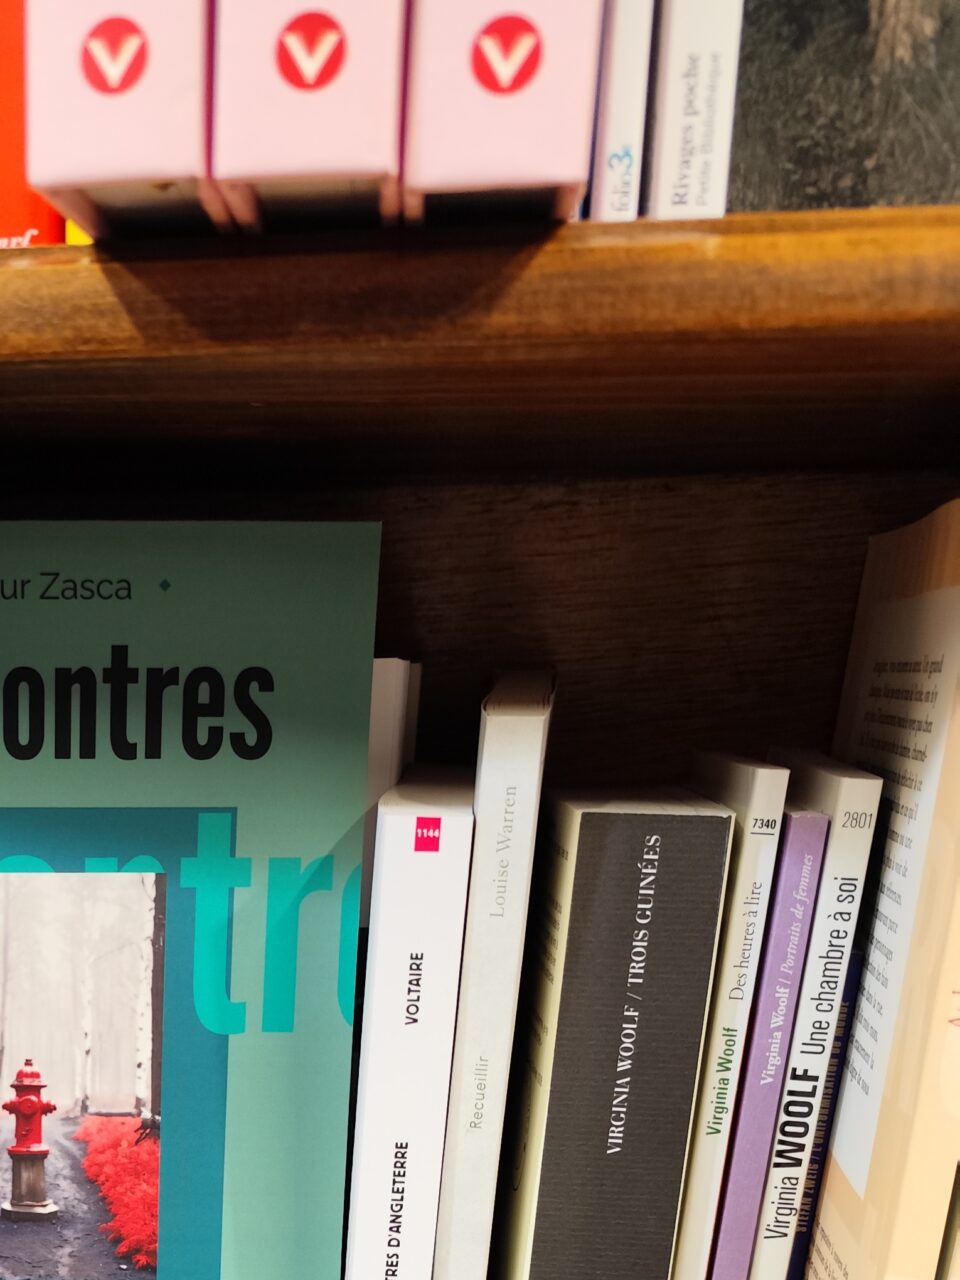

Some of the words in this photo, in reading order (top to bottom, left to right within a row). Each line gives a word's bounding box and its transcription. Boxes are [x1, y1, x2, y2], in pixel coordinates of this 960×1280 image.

[39, 572, 133, 600] Zasca
[416, 828, 440, 839] 1144
[496, 785, 517, 853] Warren
[752, 818, 777, 831] 7340
[842, 812, 873, 829] 2801
[489, 858, 510, 919] Louise
[637, 834, 662, 924] GUINÉES
[749, 882, 763, 900] lire
[795, 854, 814, 902] femmes
[837, 876, 860, 904] soi
[751, 905, 759, 918] à
[790, 901, 805, 919] de
[831, 912, 851, 922] à
[627, 931, 649, 989] TROIS
[736, 922, 755, 971] heures
[780, 918, 802, 975] Portraits
[814, 927, 849, 1014] chambre
[405, 952, 424, 1026] VOLTAIRE
[729, 976, 745, 1001] Des
[770, 985, 790, 1028] Woolf
[617, 1005, 640, 1068] WOOLF
[716, 1027, 738, 1068] Woolf
[760, 1031, 782, 1085] Virginia
[801, 1019, 830, 1055] Une
[469, 1055, 489, 1130] Recueillir
[607, 1073, 631, 1155] VIRGINIA
[706, 1071, 731, 1136] Virginia
[773, 1067, 820, 1168] WOOLF
[388, 1141, 409, 1247] D'ANGLETERRE
[764, 1177, 799, 1240] Virginia
